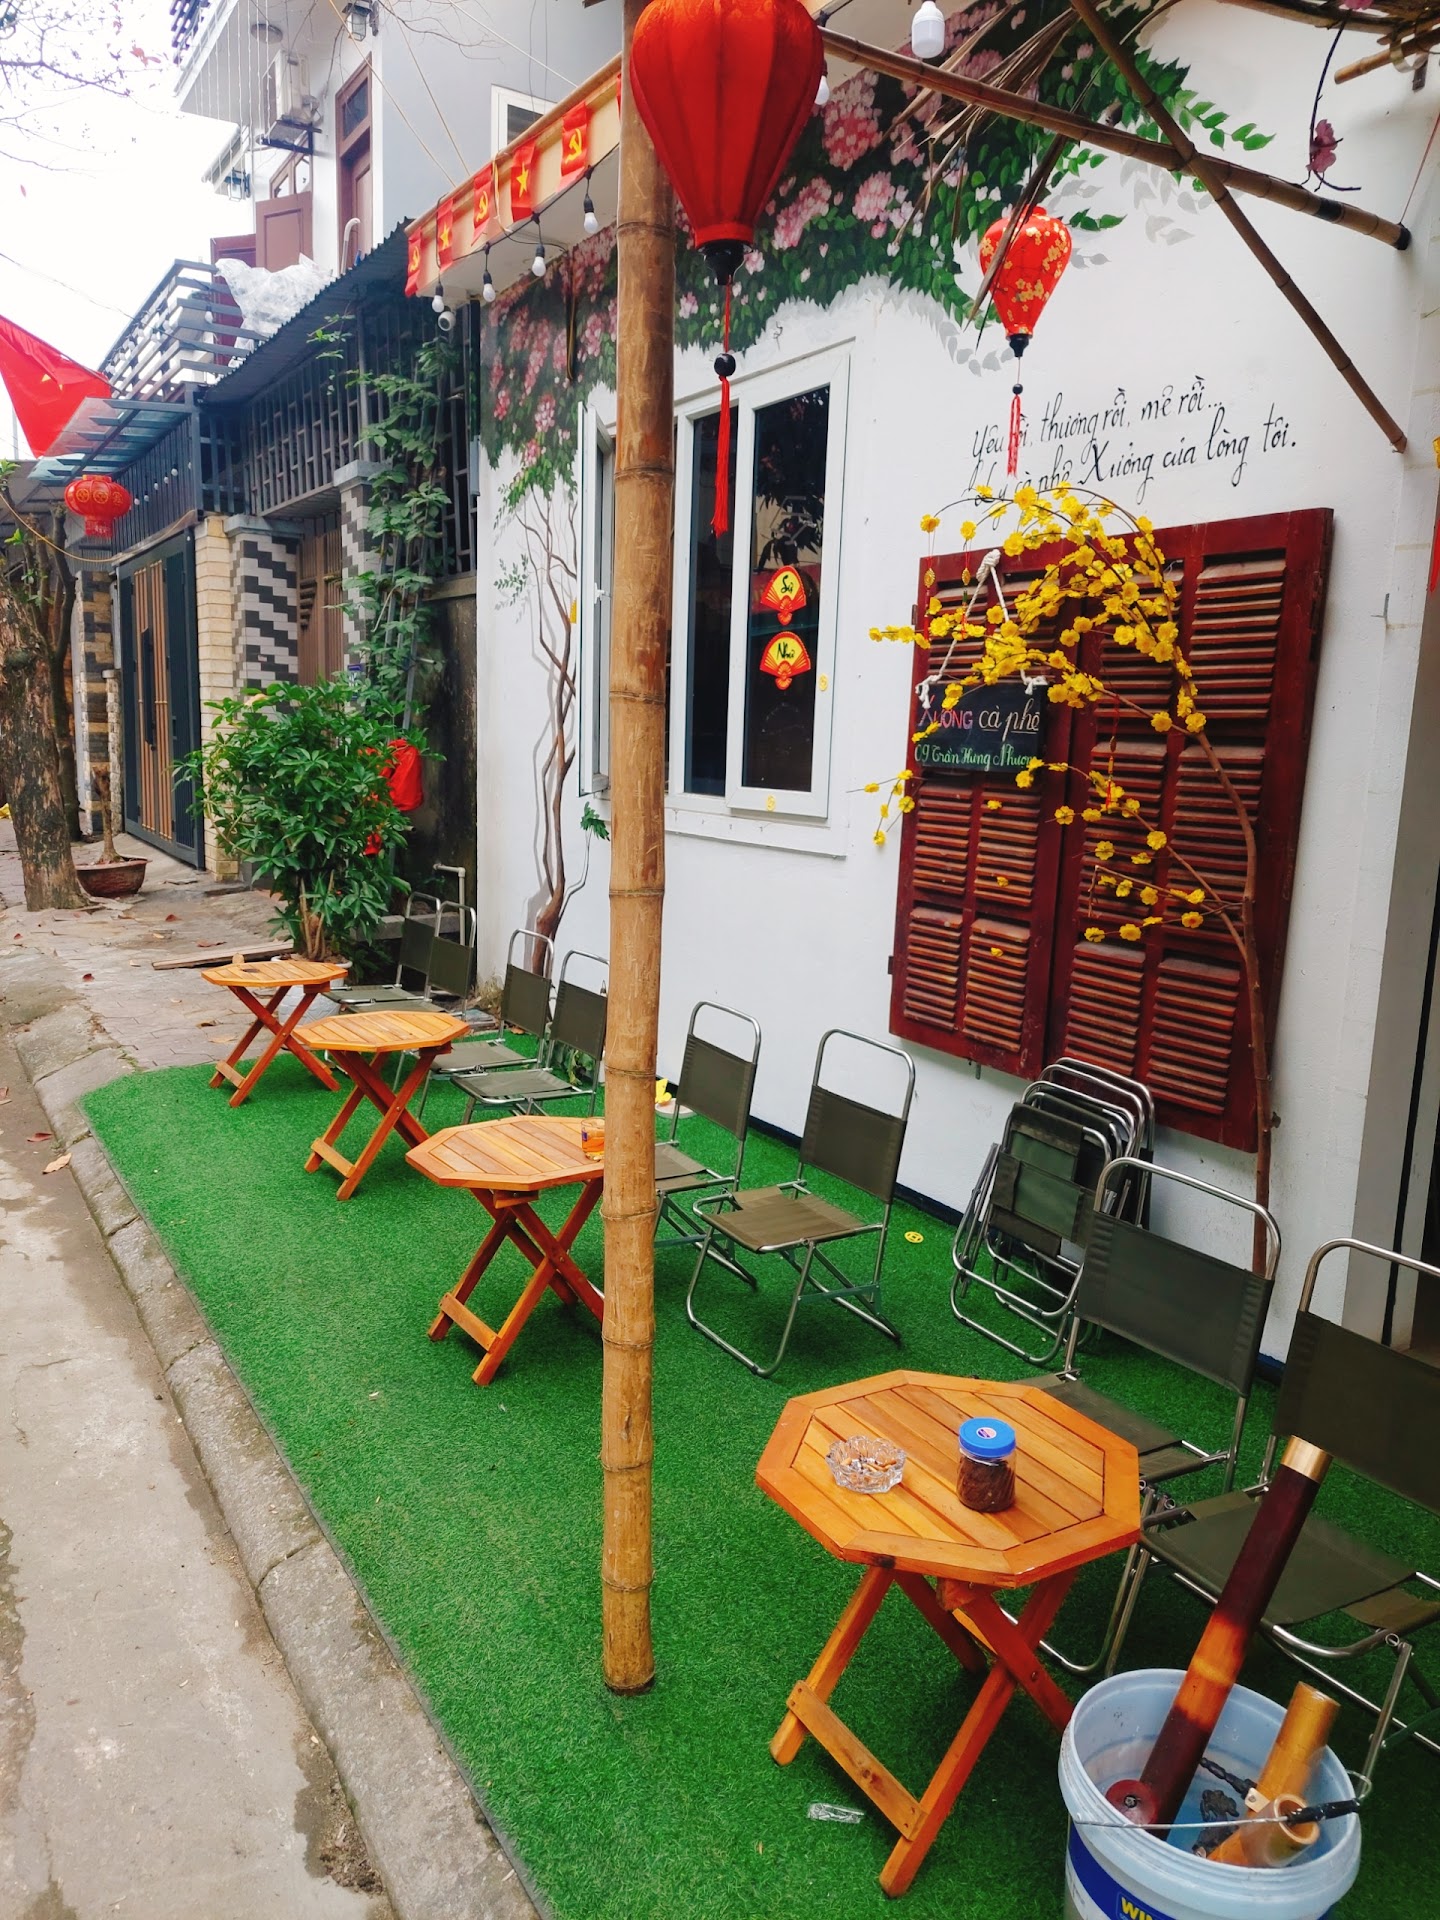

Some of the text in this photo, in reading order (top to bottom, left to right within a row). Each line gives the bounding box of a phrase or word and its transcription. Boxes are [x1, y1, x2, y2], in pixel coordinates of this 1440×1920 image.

[1141, 385, 1174, 421] mê
[1206, 406, 1250, 487] lòng
[978, 705, 1003, 730] cà
[1001, 698, 1041, 742] phê
